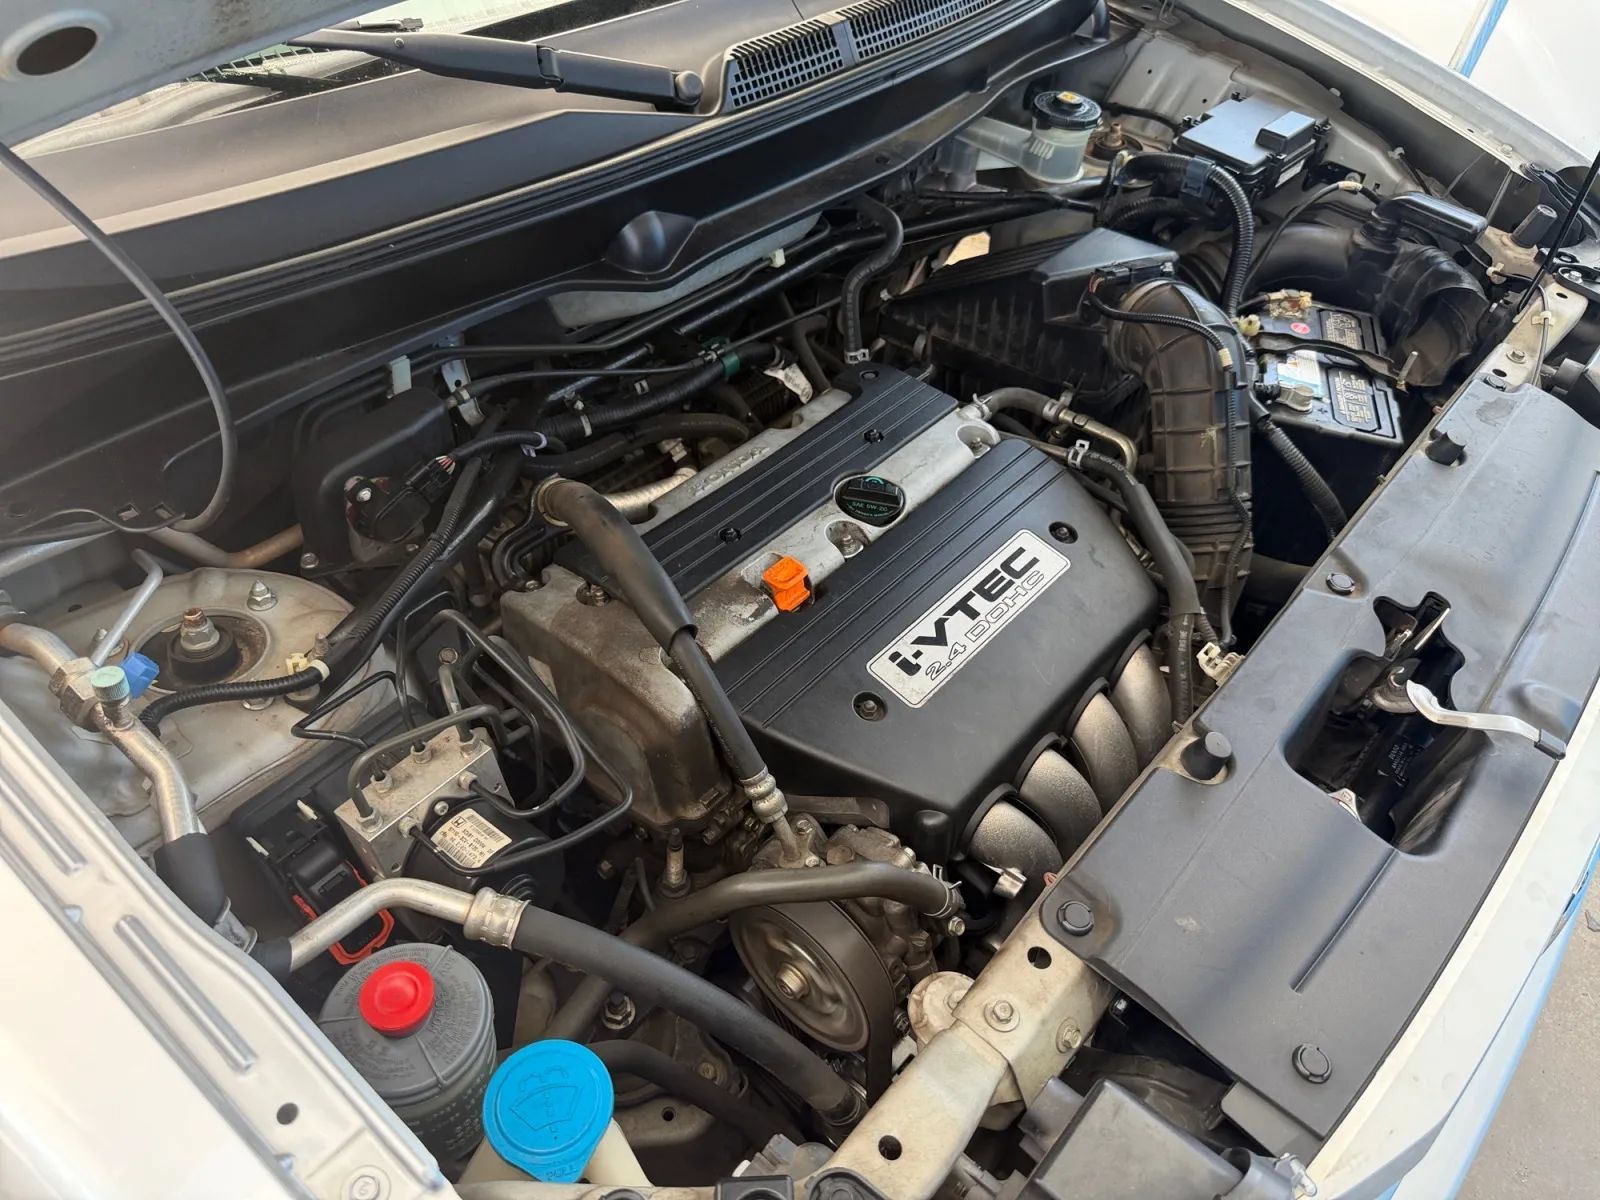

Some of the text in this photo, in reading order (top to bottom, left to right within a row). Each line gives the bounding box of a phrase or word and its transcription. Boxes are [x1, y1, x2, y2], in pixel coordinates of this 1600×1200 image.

[687, 445, 770, 498] HONDA
[851, 501, 865, 509] SAE
[888, 546, 1041, 677] i-VTEC
[925, 570, 1045, 681] 2.4 DOHC
